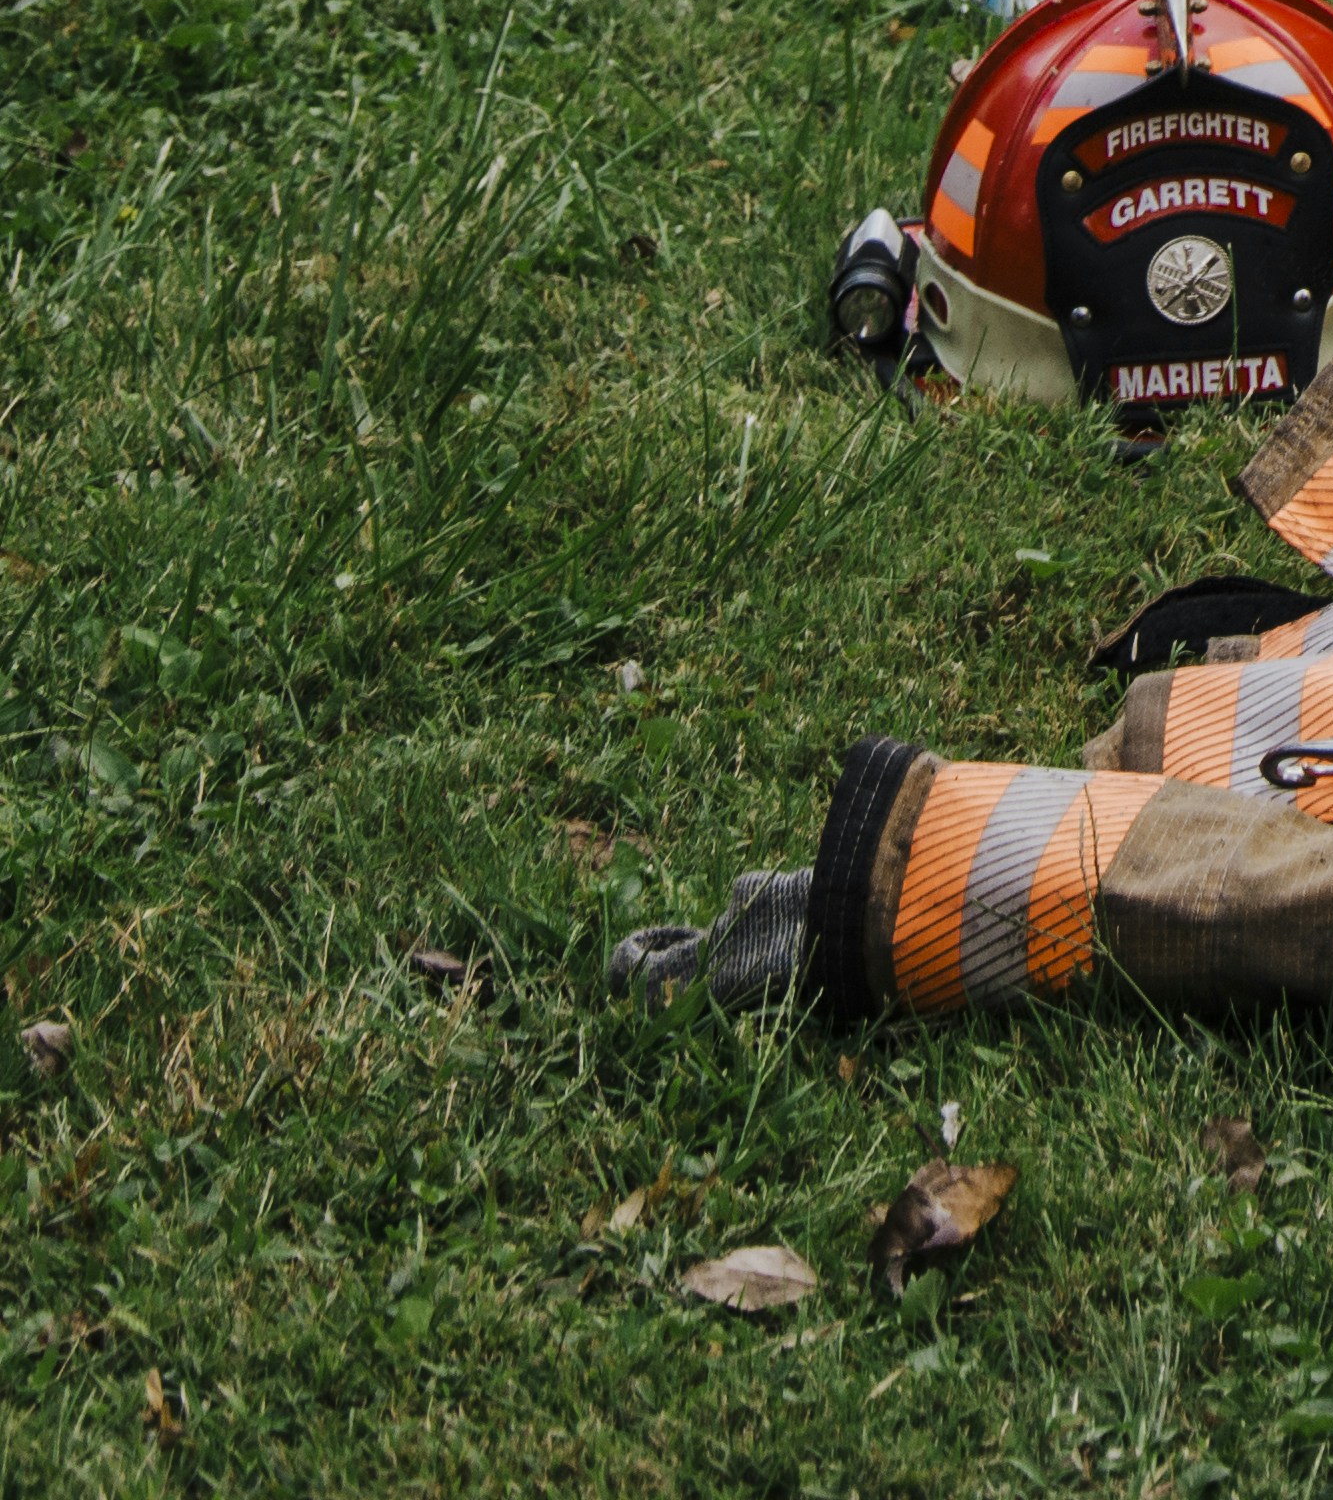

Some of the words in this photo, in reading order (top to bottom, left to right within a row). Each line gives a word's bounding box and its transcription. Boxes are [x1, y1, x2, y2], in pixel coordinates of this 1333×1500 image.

[1106, 112, 1270, 158] FIREFIGHTER
[1110, 178, 1273, 228] GARRETT
[1118, 355, 1284, 398] MARIETTA
